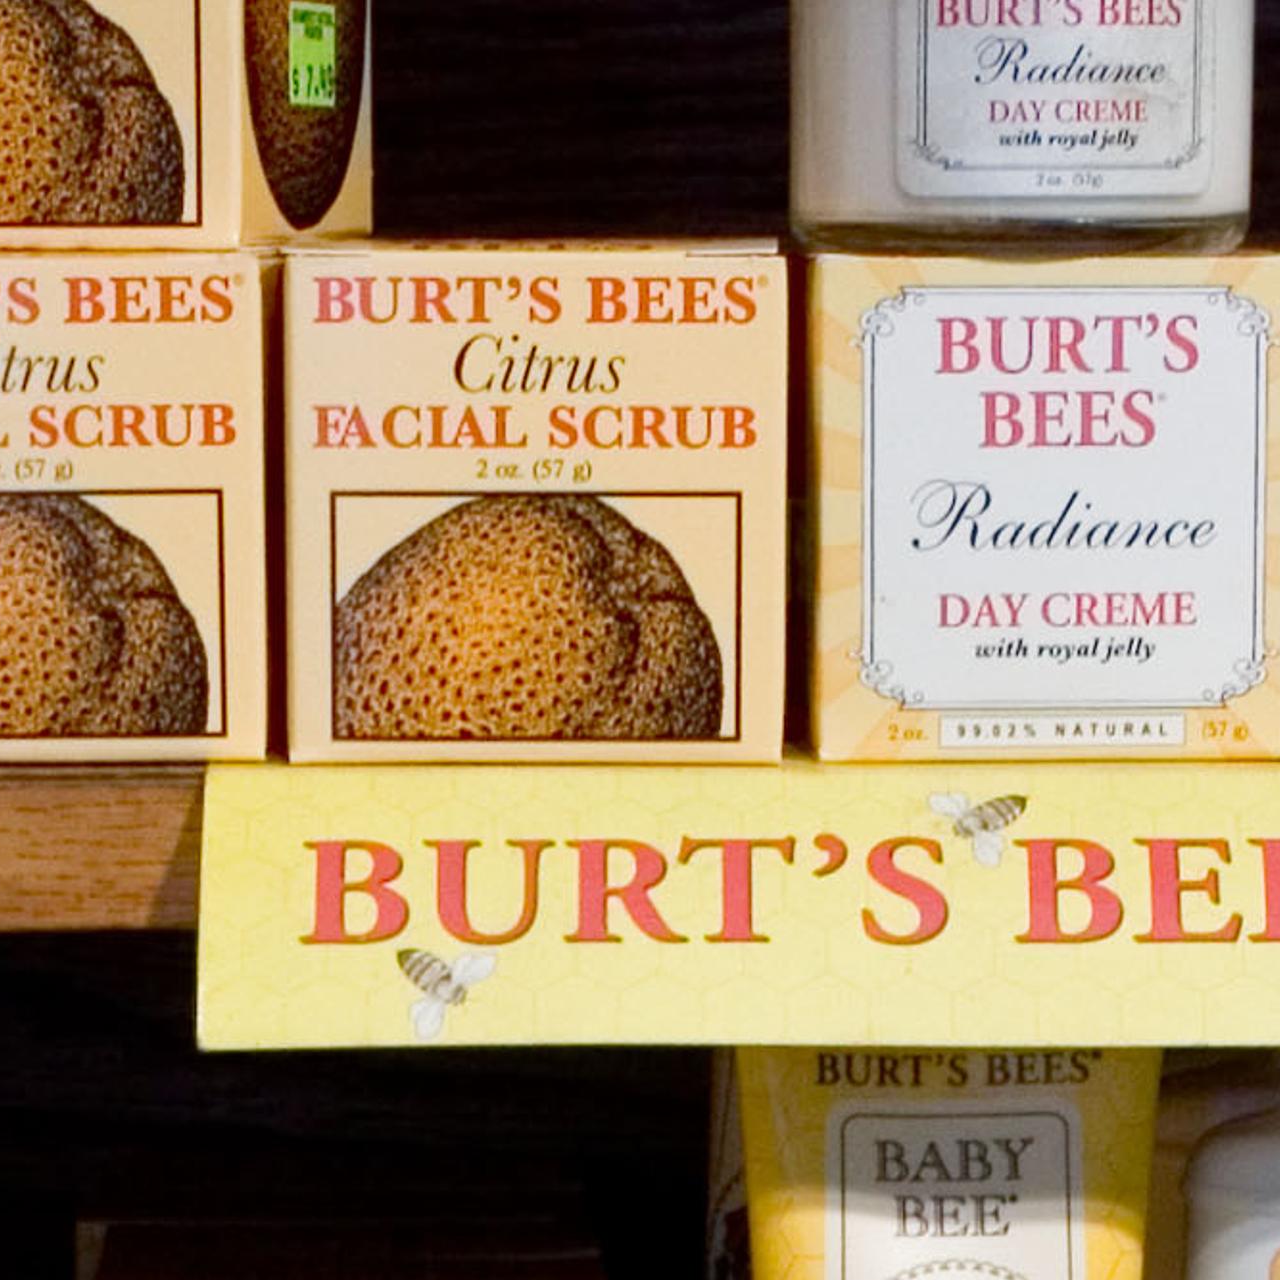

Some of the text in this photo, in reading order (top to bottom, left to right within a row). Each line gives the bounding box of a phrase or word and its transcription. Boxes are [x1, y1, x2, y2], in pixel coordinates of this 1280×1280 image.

[973, 41, 1166, 86] Radiance
[987, 99, 1148, 124] DAY CREME
[999, 129, 1139, 153] with royal jelly
[64, 276, 234, 324] BEES
[934, 314, 1199, 375] BURT'S
[28, 404, 236, 448] SCRUB
[979, 390, 1157, 448] BEES
[15, 459, 45, 482] (57
[54, 460, 74, 483] g)
[910, 479, 1218, 552] Radiance
[938, 592, 1198, 628] DAY CREME
[975, 638, 1156, 666] with royal jelly
[1054, 722, 1171, 738] NATURAL
[298, 833, 951, 946] BURT'S
[814, 1051, 1090, 1087] BURT'S BEES
[875, 1138, 1035, 1184] BABY
[894, 1194, 1011, 1236] BEE
